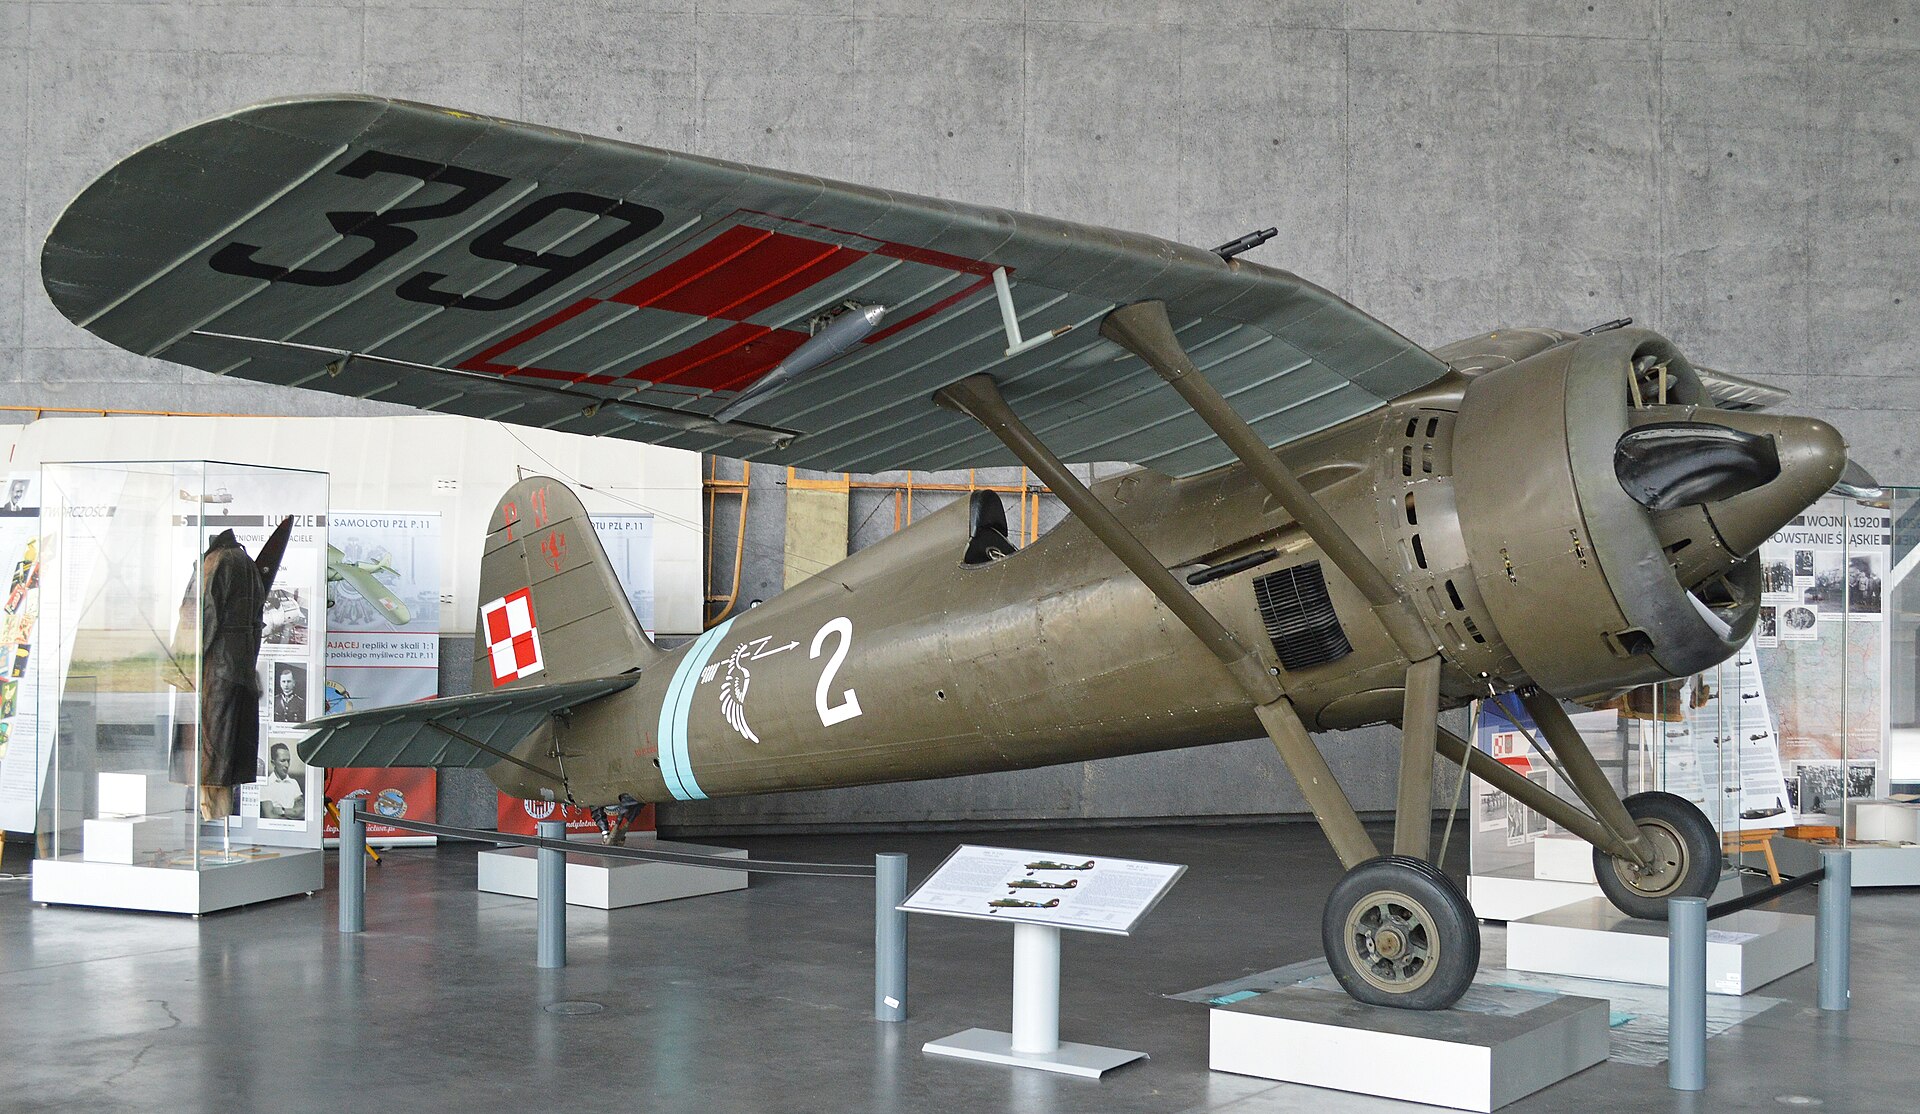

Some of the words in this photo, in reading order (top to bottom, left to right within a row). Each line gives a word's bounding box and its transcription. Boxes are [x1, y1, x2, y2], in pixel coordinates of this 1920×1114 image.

[209, 149, 664, 312] 39
[267, 515, 314, 527] LUZIE
[334, 518, 389, 528] SAMOLOTU
[392, 520, 408, 529] PZL
[410, 520, 430, 529] P.11
[608, 522, 623, 530] PZL
[625, 522, 644, 530] P.11
[1806, 515, 1852, 527] WOJN
[1854, 517, 1880, 528] 1920
[1835, 531, 1880, 547] ŚĄSKIE
[327, 641, 360, 650] AJĄCEJ
[362, 641, 388, 650] repliki
[400, 641, 420, 650] skali
[422, 642, 434, 650] 1:1
[331, 651, 368, 659] polskiego
[369, 651, 404, 660] myśliwca
[406, 651, 417, 659] PZL
[809, 616, 863, 728] 2
